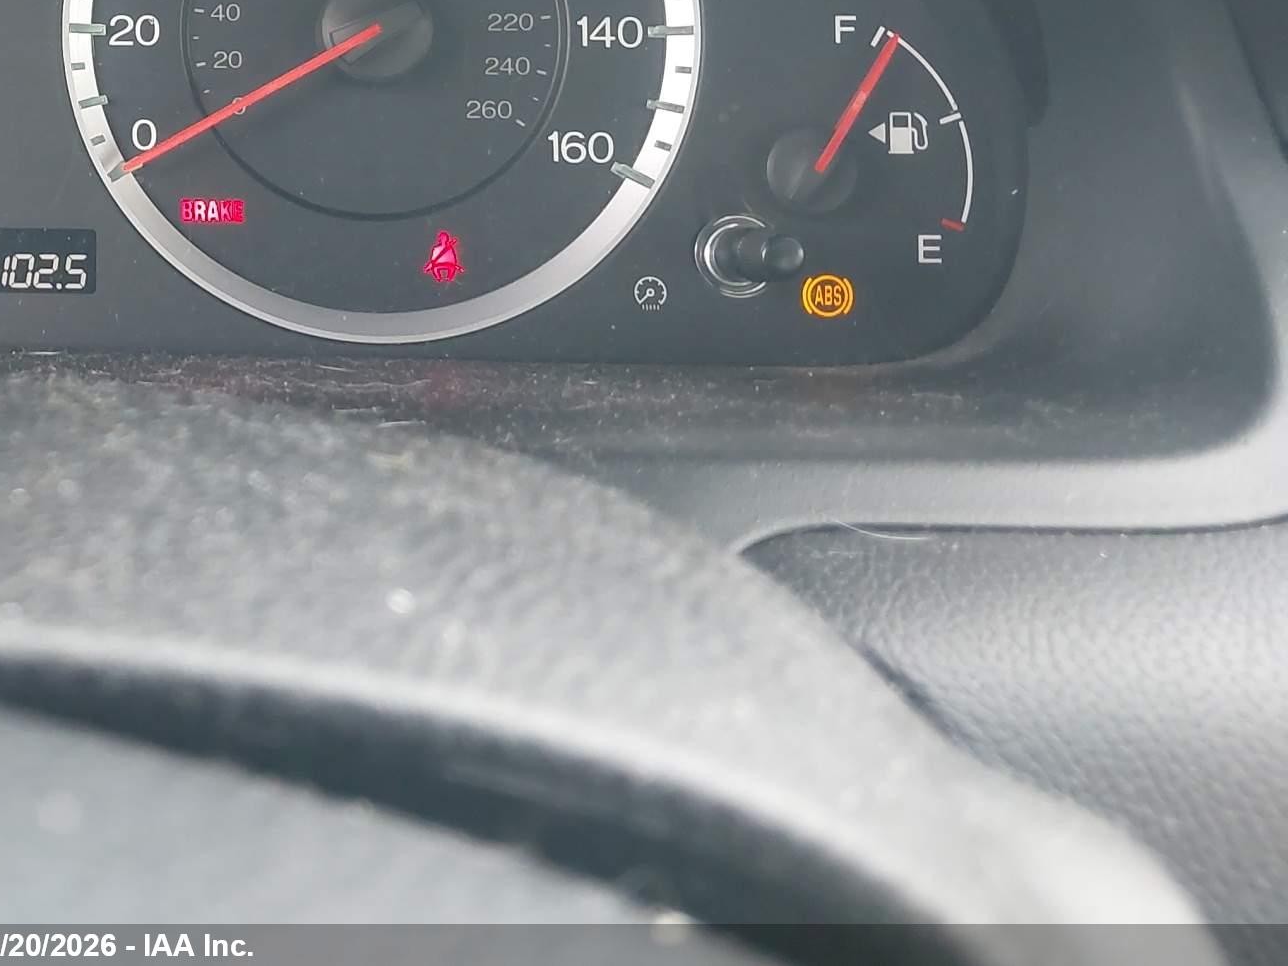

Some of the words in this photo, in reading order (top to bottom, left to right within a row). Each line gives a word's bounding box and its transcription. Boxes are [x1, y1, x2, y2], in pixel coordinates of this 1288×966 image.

[211, 4, 240, 21] 40
[488, 13, 533, 31] 220
[108, 15, 159, 45] 20
[577, 17, 642, 48] 140
[835, 16, 856, 43] F
[214, 51, 241, 68] 20
[486, 57, 529, 75] 240
[467, 101, 512, 118] 260
[133, 120, 156, 150] 0
[548, 132, 613, 163] 160
[181, 200, 244, 222] BRAKE
[918, 235, 942, 263] E
[1, 253, 87, 290] 102.5
[814, 286, 842, 306] ABS
